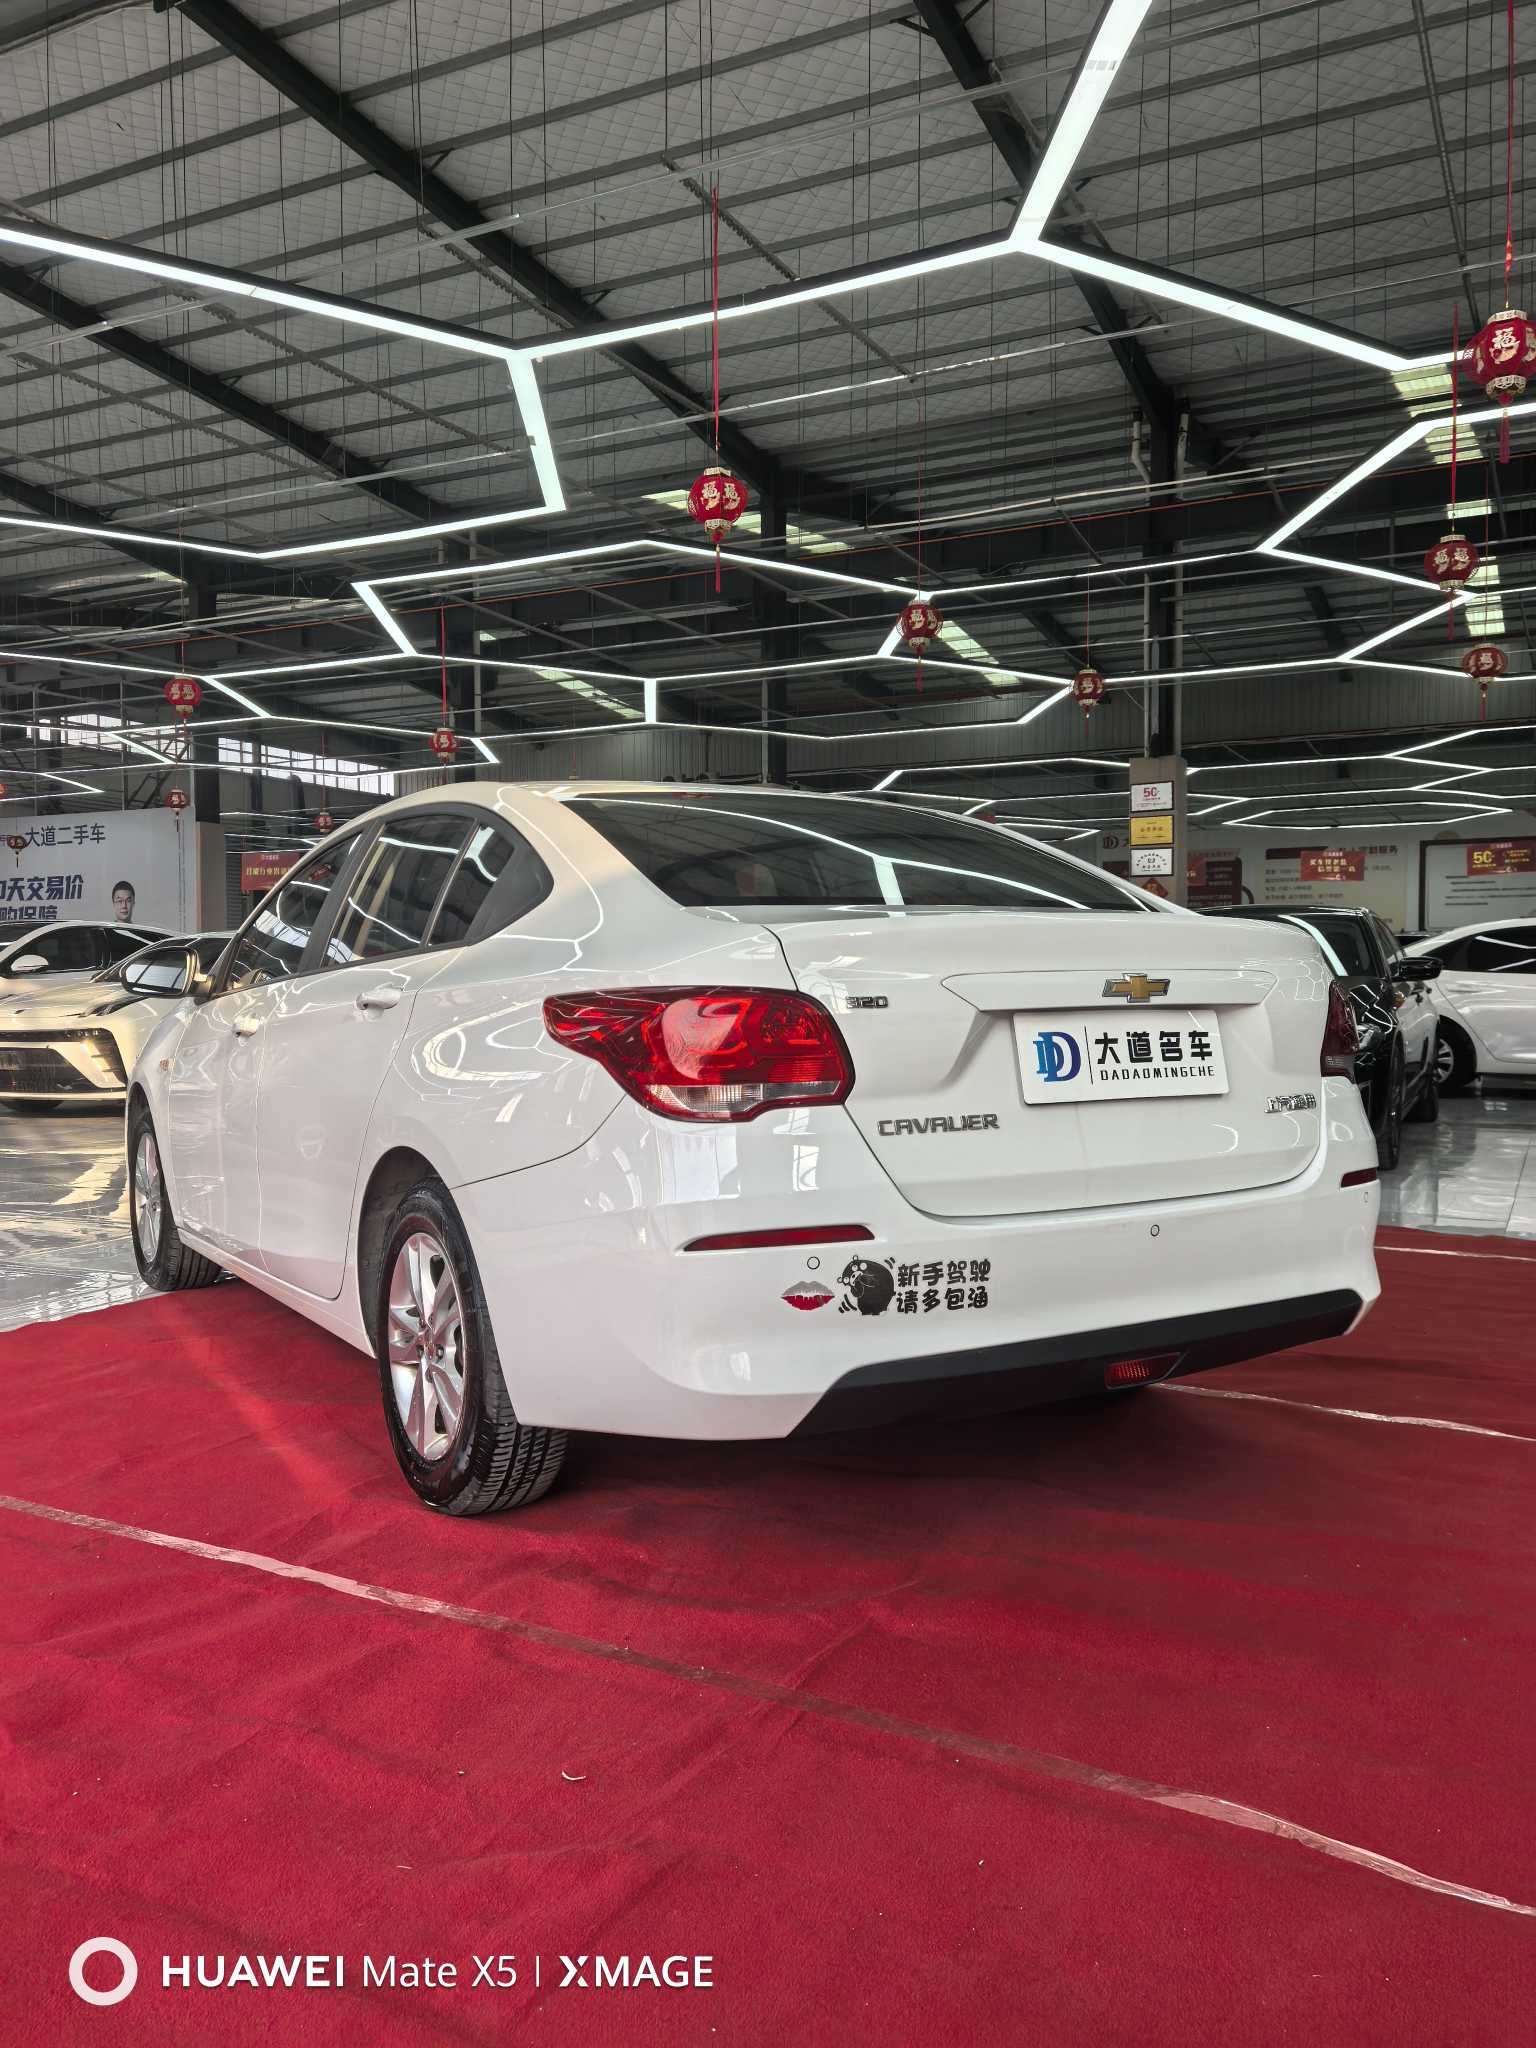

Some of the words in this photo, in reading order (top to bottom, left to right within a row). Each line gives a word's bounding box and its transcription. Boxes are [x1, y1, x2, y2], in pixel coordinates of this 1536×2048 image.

[25, 823, 106, 847] 大道二手车
[1095, 1029, 1213, 1065] 大道名车
[1100, 1064, 1215, 1081] DADAOMINGCHE
[877, 1113, 1000, 1137] CAVALIER
[897, 1258, 991, 1288] 新手驾驶
[896, 1285, 989, 1315] 请多包涵
